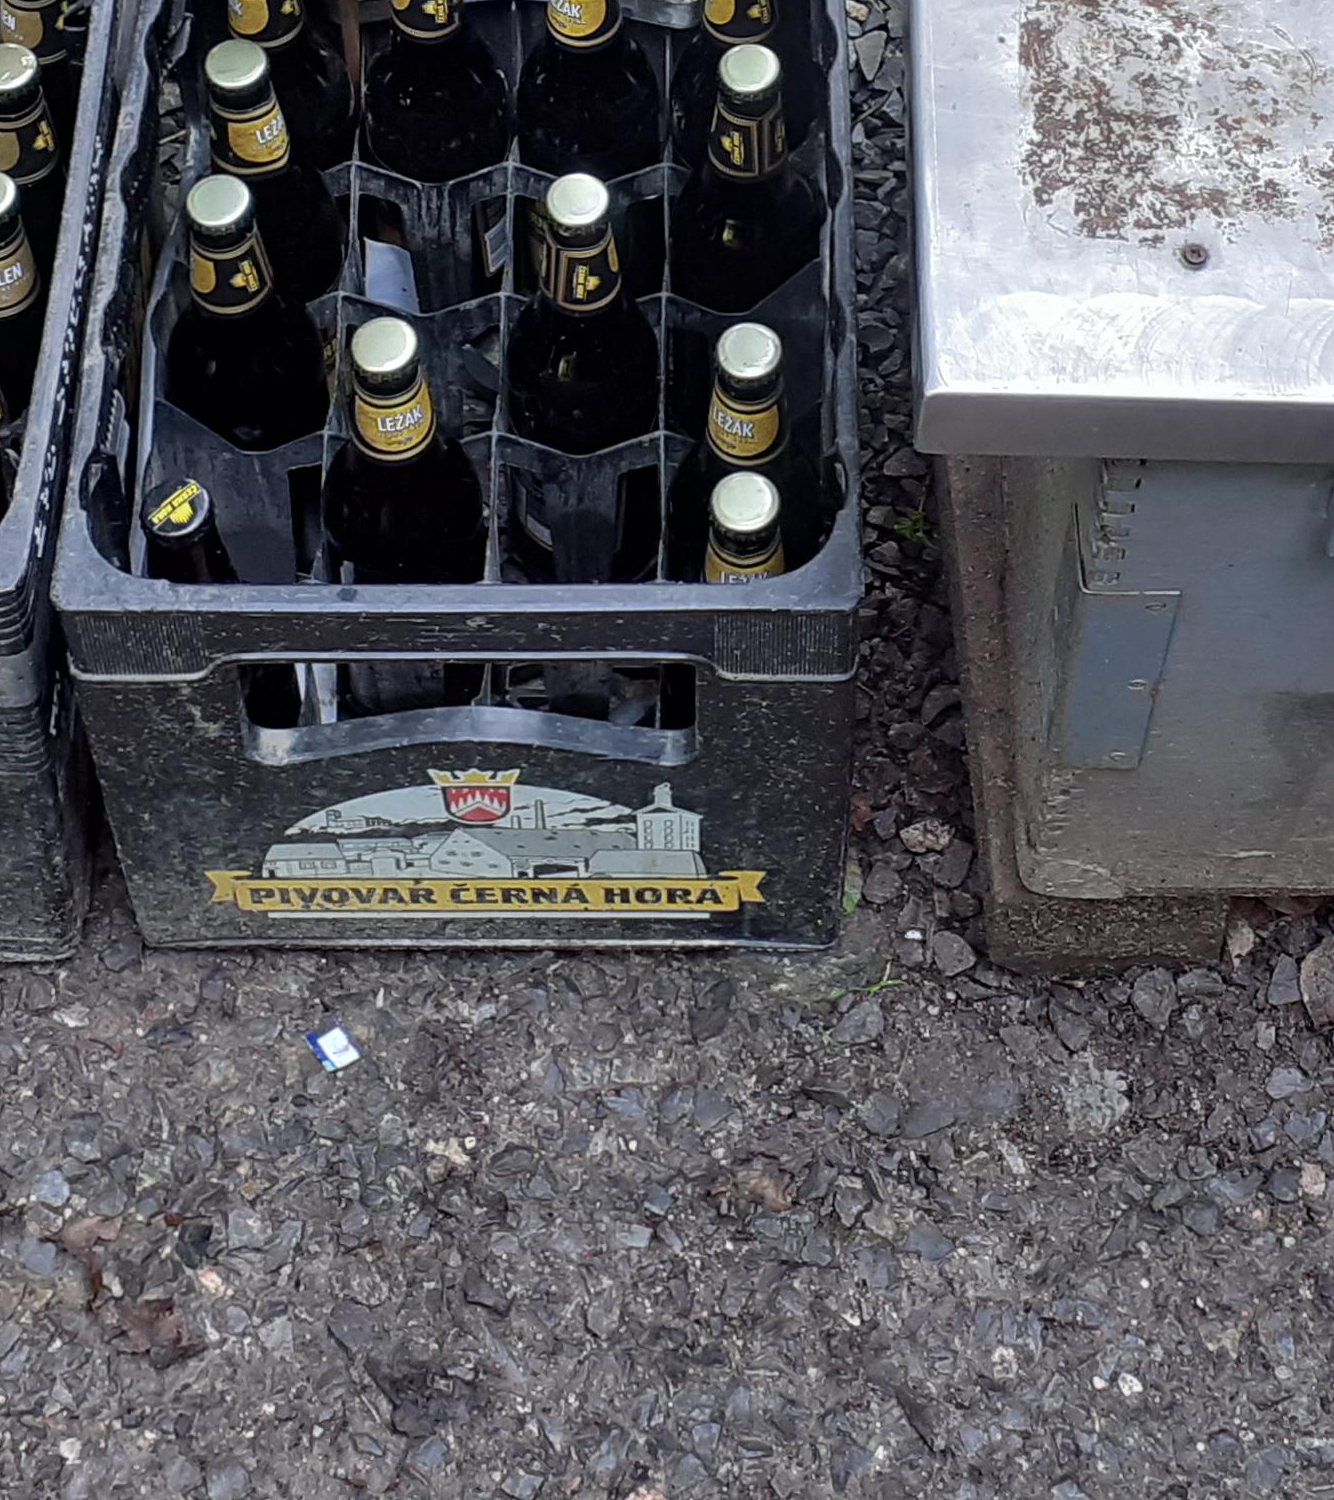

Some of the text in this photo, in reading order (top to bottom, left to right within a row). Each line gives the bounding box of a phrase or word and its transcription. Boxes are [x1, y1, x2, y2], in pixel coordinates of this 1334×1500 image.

[252, 882, 725, 905] PIVOVAR ČERNÁ HORA
